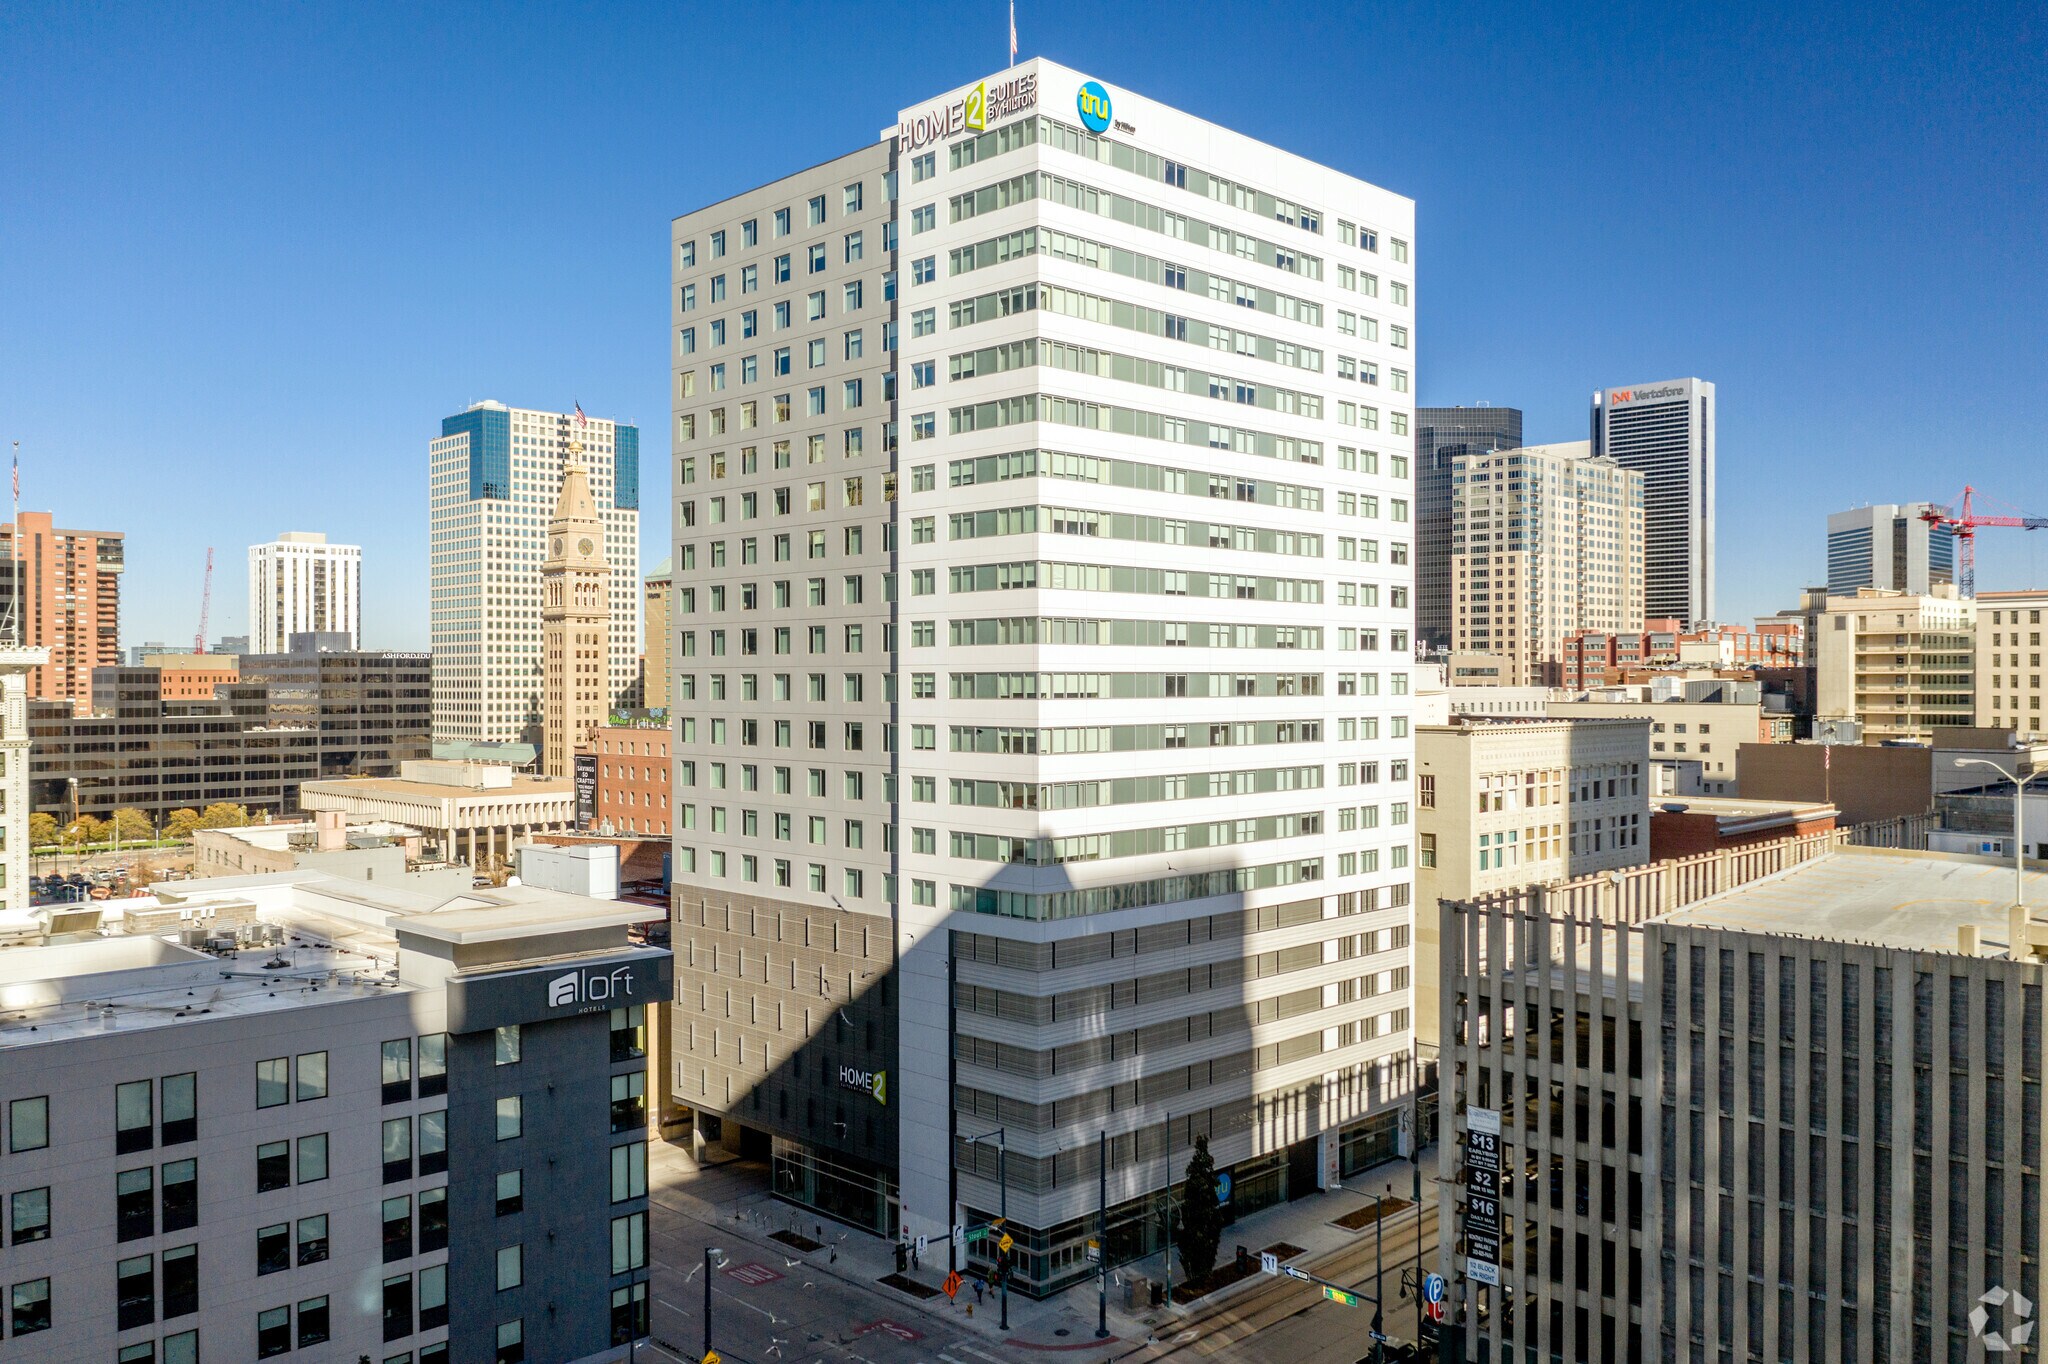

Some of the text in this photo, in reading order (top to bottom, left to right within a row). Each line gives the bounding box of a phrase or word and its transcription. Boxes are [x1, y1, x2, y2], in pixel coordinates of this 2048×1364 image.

[987, 72, 1037, 105] SUITES
[988, 91, 1037, 120] BY HILTON
[1080, 87, 1108, 120] tru
[1633, 386, 1684, 401] Vertafore
[577, 777, 595, 785] CRAFTED
[549, 966, 634, 1008] aloft
[578, 1004, 606, 1013] HOTELS
[1471, 1133, 1494, 1151] $13
[1475, 1171, 1492, 1187] $2
[1470, 1184, 1480, 1192] PER
[1471, 1198, 1494, 1216] $16
[1470, 1213, 1483, 1221] DAILY
[1484, 1217, 1496, 1225] MAX
[968, 1231, 982, 1241] Stout
[1470, 1269, 1495, 1282] ON RIGHT
[1477, 1263, 1496, 1274] BLOCK
[1433, 1279, 1441, 1300] P
